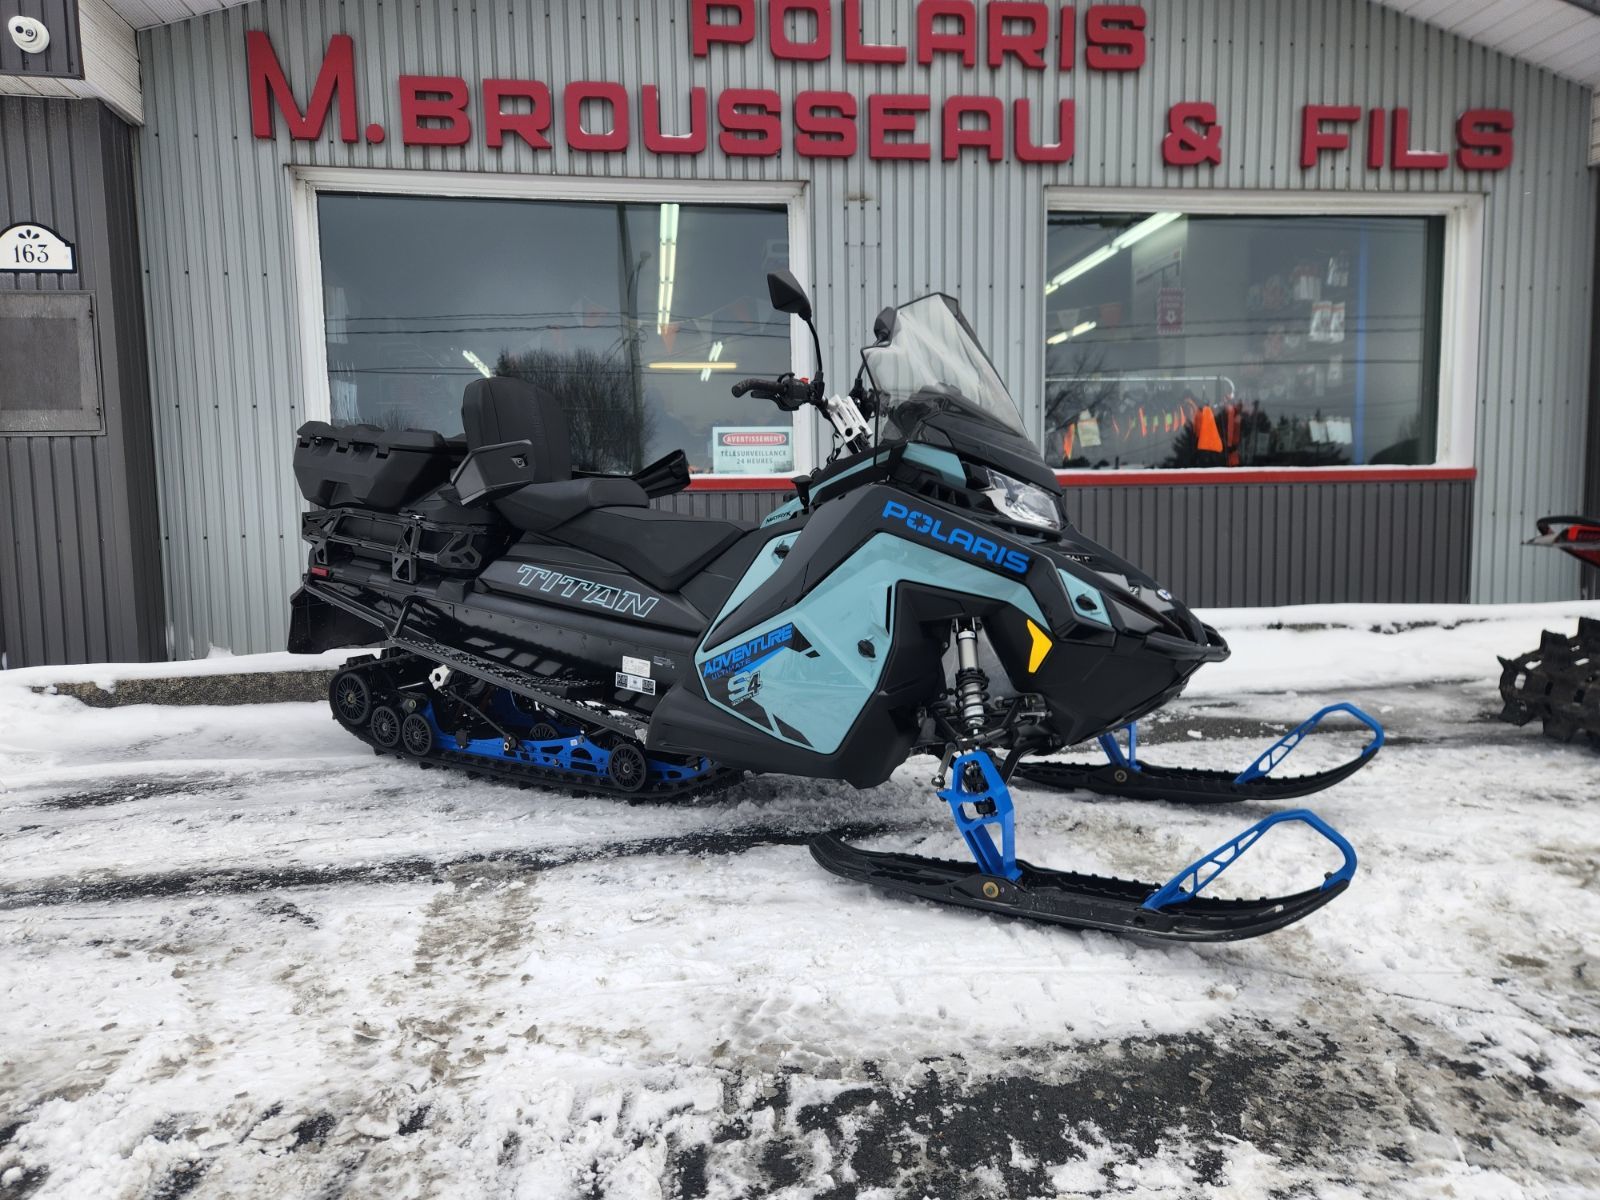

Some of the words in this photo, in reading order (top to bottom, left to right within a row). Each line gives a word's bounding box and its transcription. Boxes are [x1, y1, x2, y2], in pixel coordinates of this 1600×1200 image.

[691, 0, 1147, 71] POLARIS
[1162, 102, 1223, 166] &
[1301, 105, 1514, 170] FILS
[14, 243, 49, 263] 163
[726, 435, 783, 443] AVERTISSEMENT
[746, 457, 773, 465] HEURES
[882, 500, 1030, 575] POLARIS
[517, 563, 660, 618] TITAN
[703, 623, 793, 678] ADVENTURE
[711, 658, 753, 680] ULTIMATE
[727, 670, 763, 702] S4
